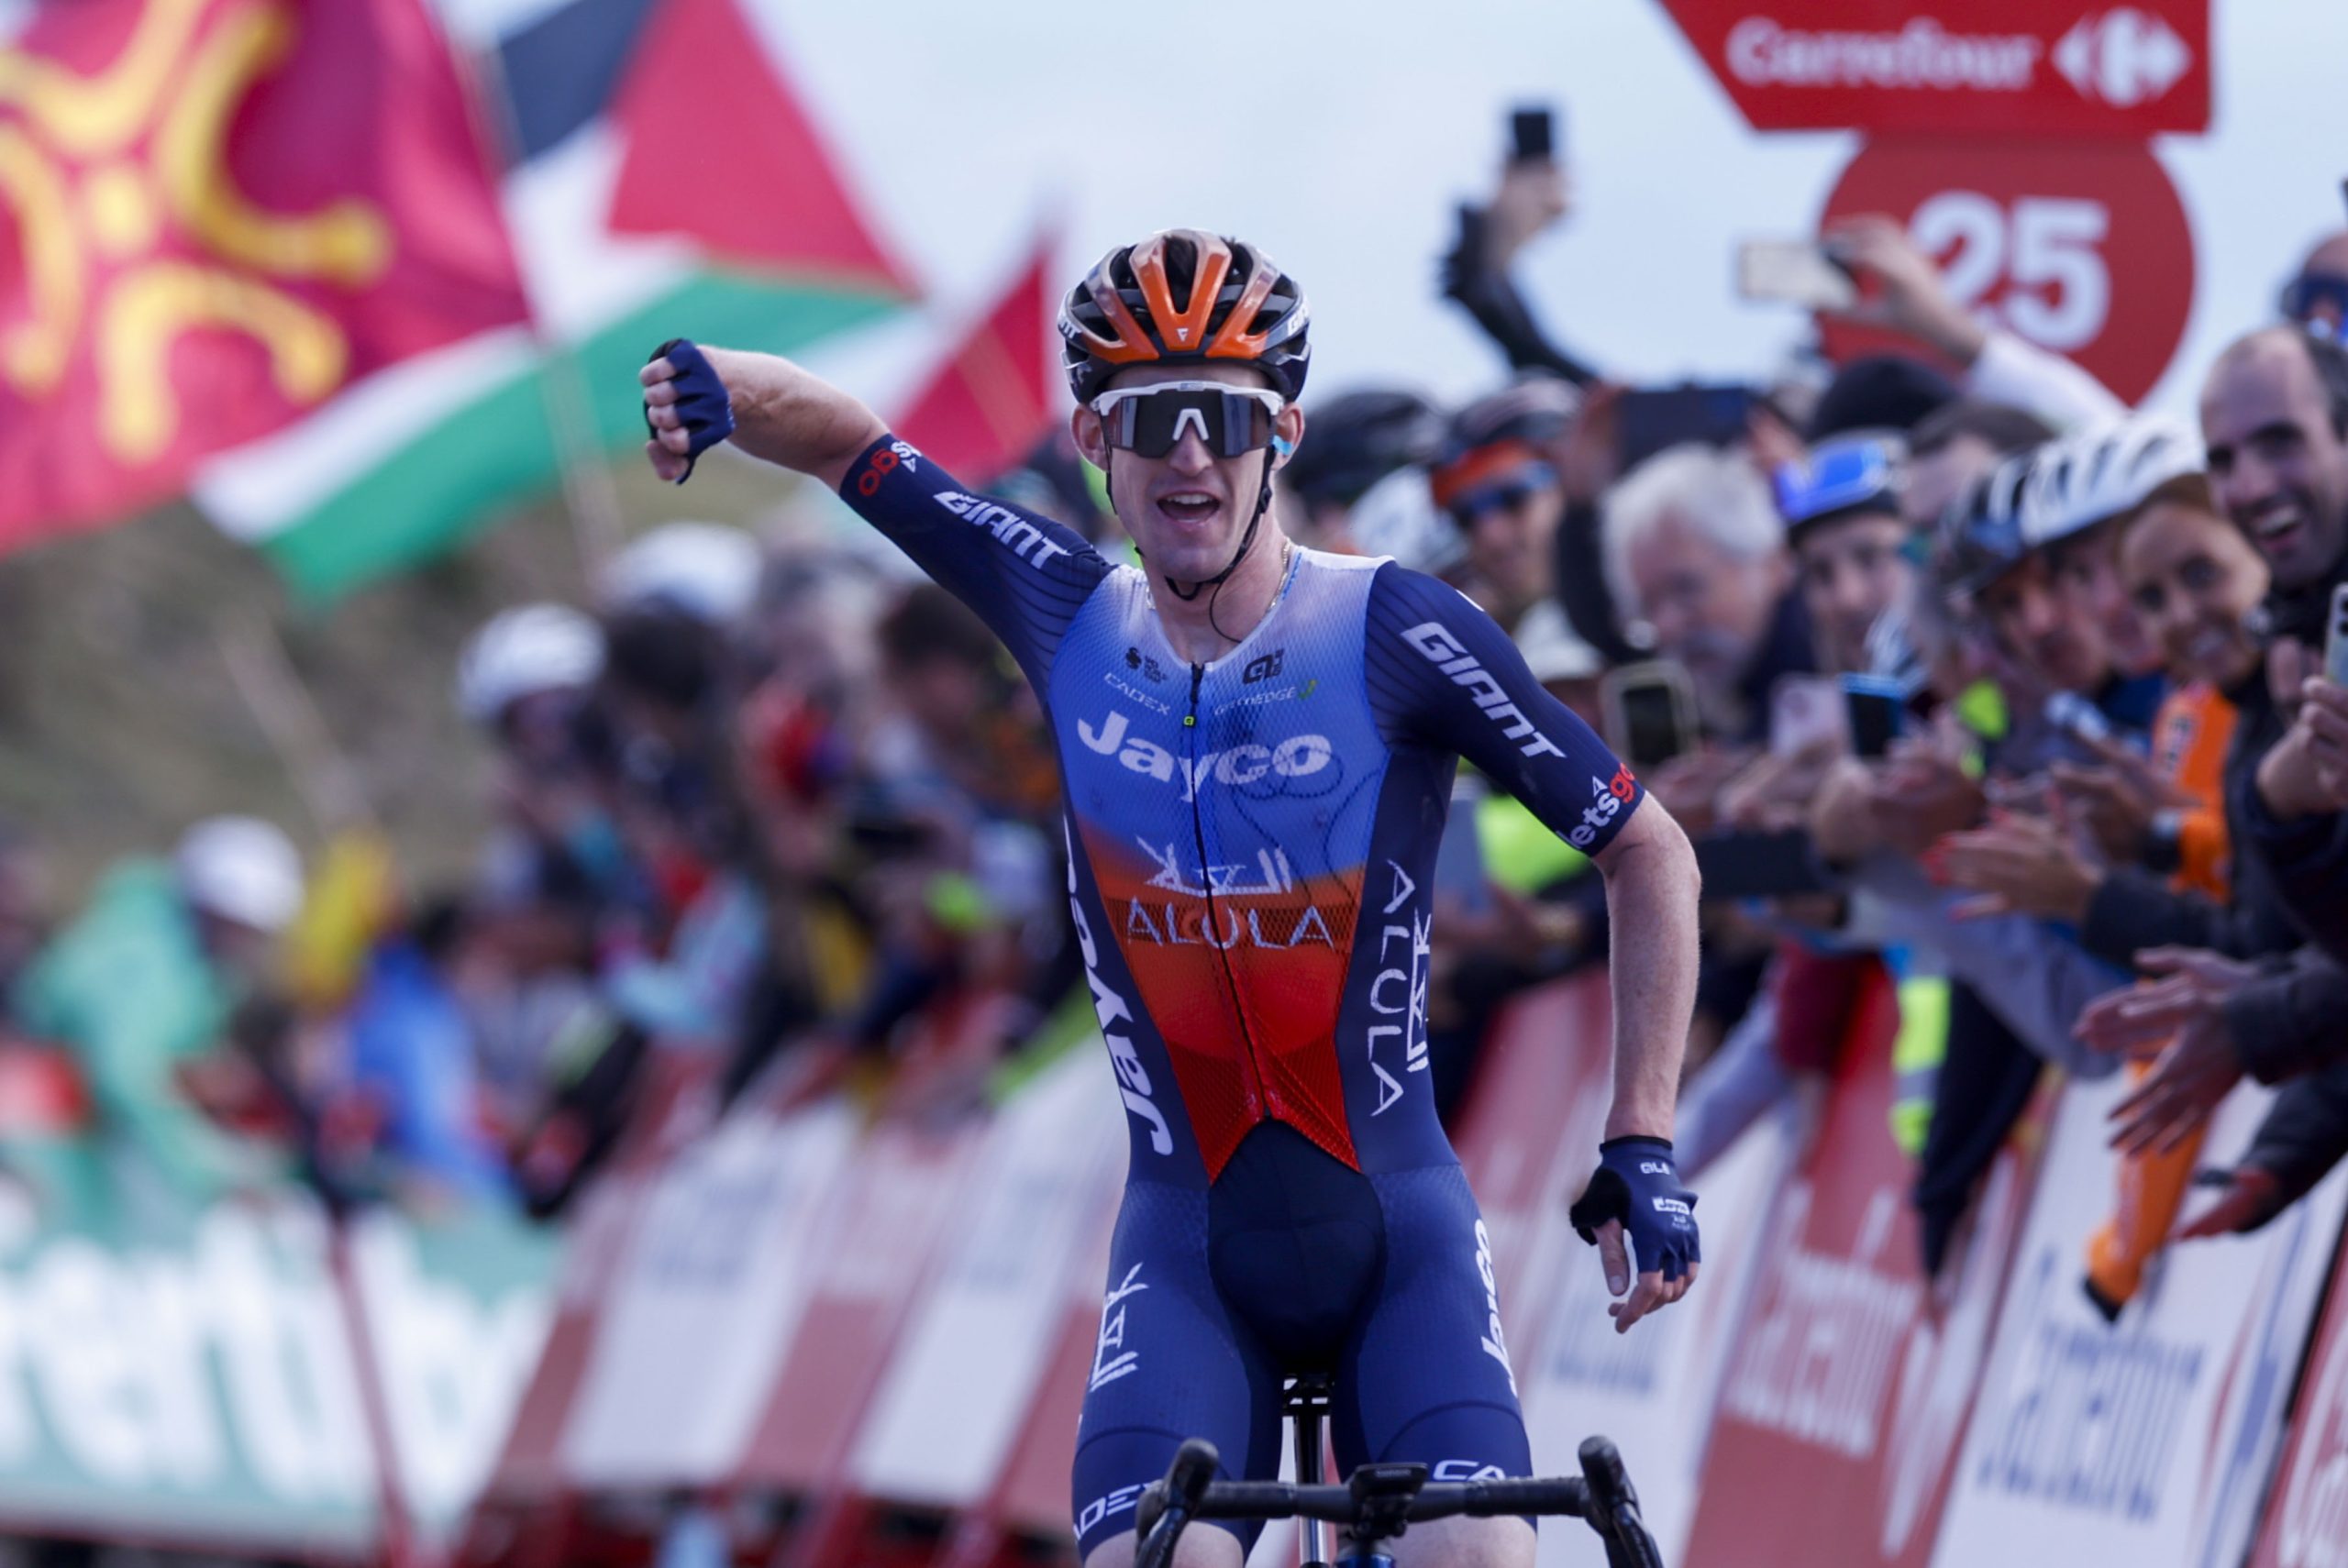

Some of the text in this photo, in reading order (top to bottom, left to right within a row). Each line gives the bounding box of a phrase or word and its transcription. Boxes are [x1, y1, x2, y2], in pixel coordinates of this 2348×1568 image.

[1725, 15, 2042, 90] Carrefour
[1908, 189, 2111, 352] 25
[933, 491, 1071, 569] GIANT
[1103, 672, 1171, 716] CADEX
[1401, 622, 1567, 758] GIANT
[1077, 710, 1333, 803] Jayco
[1126, 896, 1336, 953] ALULA
[1063, 812, 1174, 1156] Jayc
[1367, 858, 1416, 1117] ALULA
